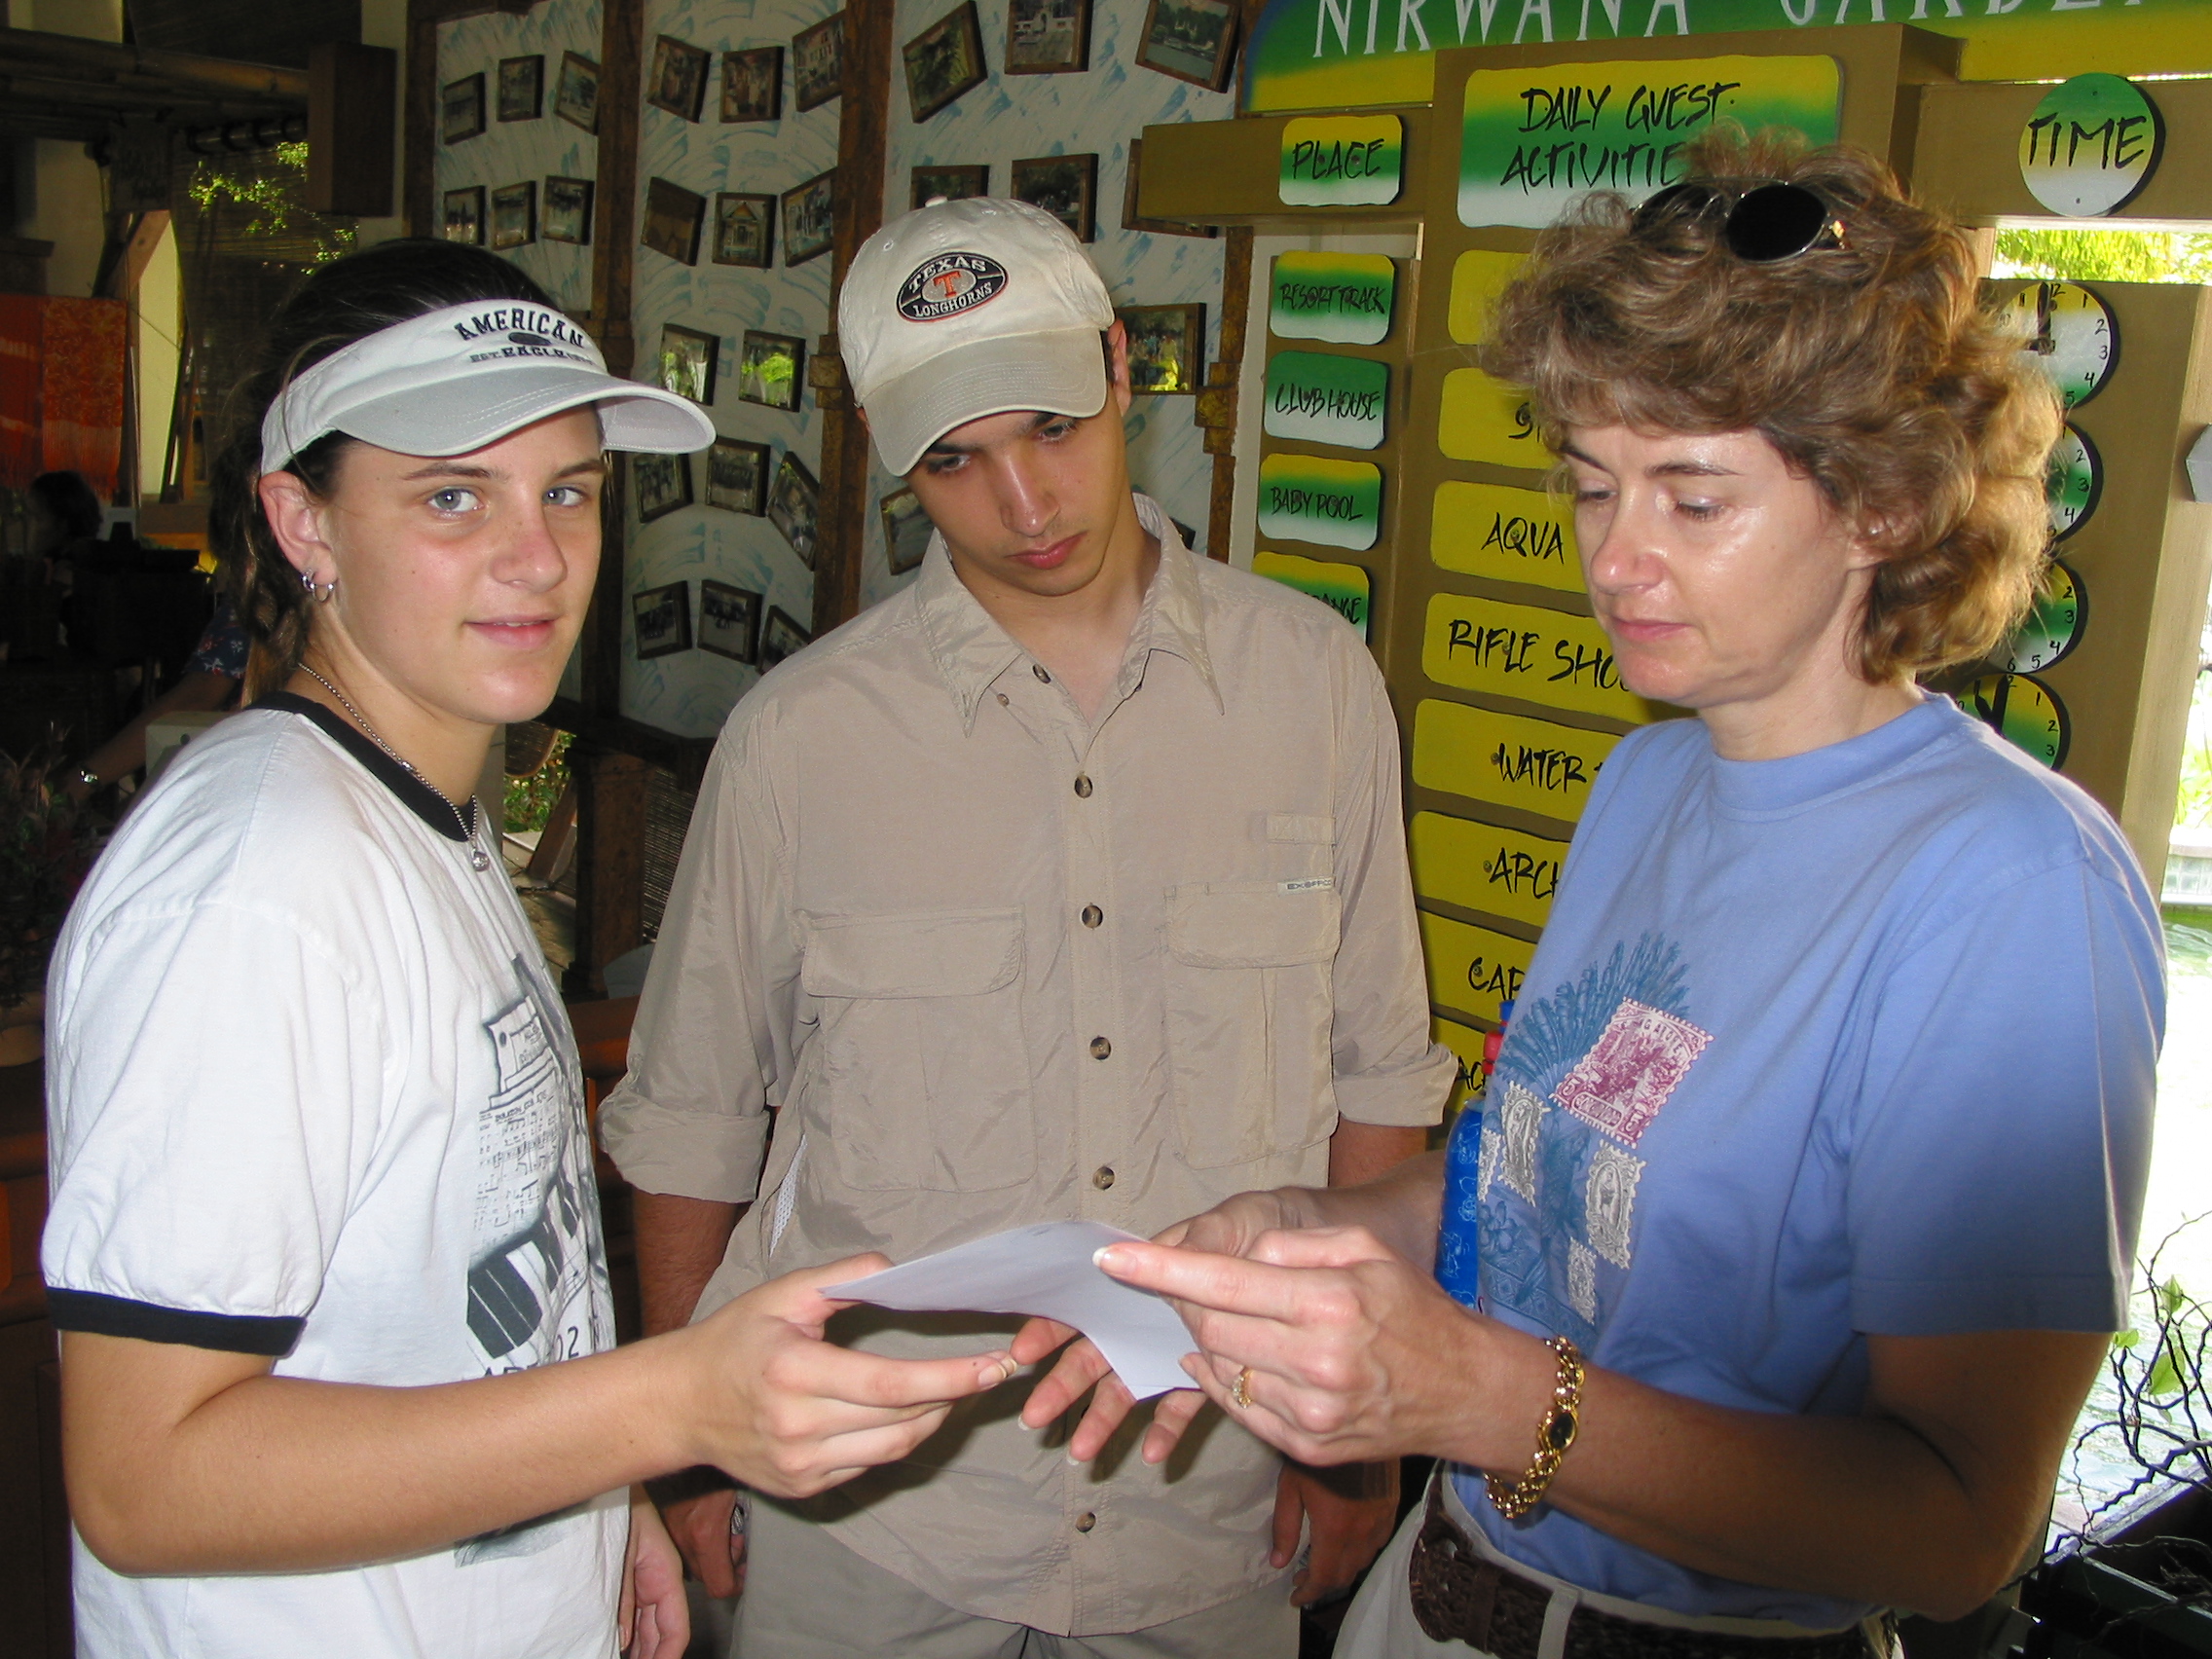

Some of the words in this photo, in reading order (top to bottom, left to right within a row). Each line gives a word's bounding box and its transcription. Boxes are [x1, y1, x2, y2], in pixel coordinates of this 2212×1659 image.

[1517, 85, 1612, 134] DAILY
[2027, 112, 2148, 170] TIME
[1292, 138, 1386, 181] PLACE
[1500, 141, 1688, 195] ACTIVITIE
[908, 255, 987, 293] TEXAS
[932, 271, 961, 298] T
[912, 281, 993, 317] LONGHORNS
[1280, 282, 1341, 313] RESORT
[454, 308, 585, 349] AMERICAN
[2094, 318, 2108, 335] 2
[500, 345, 569, 359] EAGLE
[2098, 346, 2108, 360] 3
[2084, 372, 2095, 388] 4
[1273, 383, 1325, 416] CLUB
[1326, 387, 1381, 422] HOUSE
[2063, 390, 2076, 407] 5
[2076, 449, 2086, 463] 2
[2077, 477, 2089, 493] 3
[1272, 487, 1312, 519] BABY
[1315, 493, 1363, 522] POOL
[2064, 506, 2076, 524] 4
[2062, 585, 2074, 600] 2
[2064, 609, 2075, 623] 3
[1449, 619, 1541, 674] RIFLE
[2048, 640, 2061, 655] 4
[2007, 657, 2016, 673] 6
[2031, 654, 2042, 669] 5
[2047, 719, 2058, 733] 2
[2046, 744, 2055, 756] 3
[1495, 742, 1588, 793] WATER
